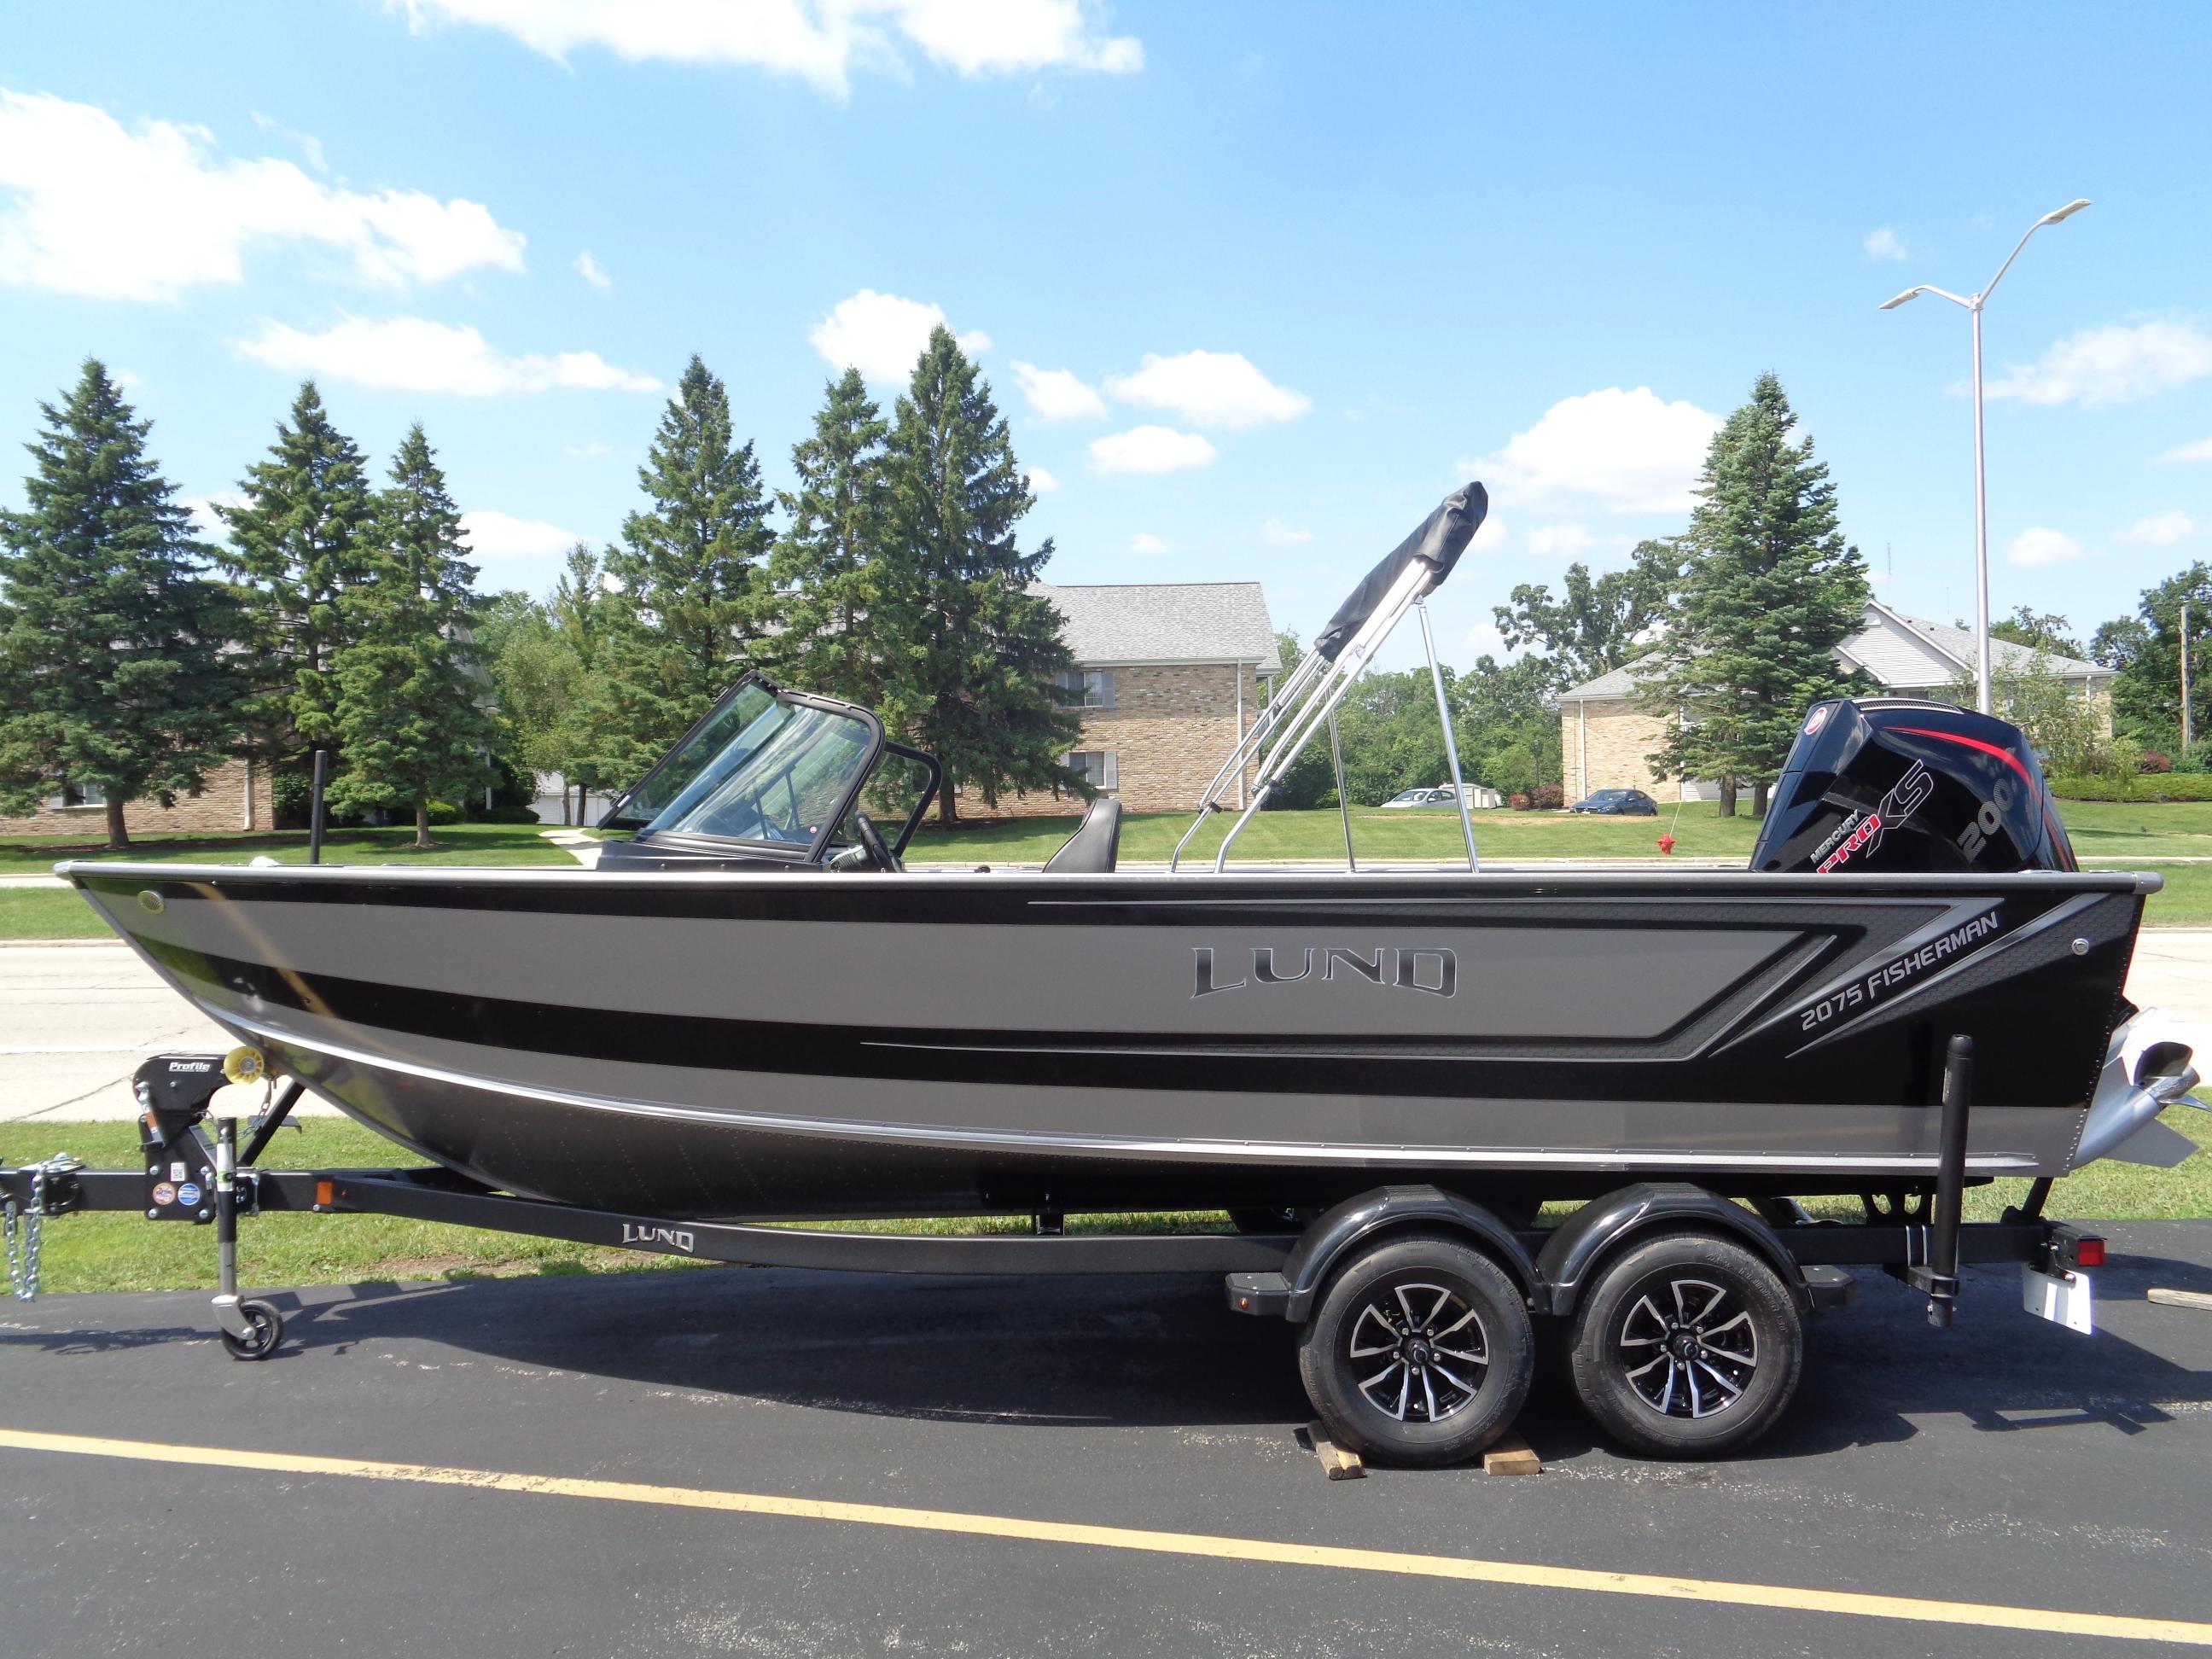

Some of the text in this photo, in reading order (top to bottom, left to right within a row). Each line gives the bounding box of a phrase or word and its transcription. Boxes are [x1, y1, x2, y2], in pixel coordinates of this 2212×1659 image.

[1809, 809, 1859, 864] MERCURY
[1957, 777, 2014, 864] 200
[1190, 947, 1458, 998] LUND
[1800, 911, 1998, 1031] 2075 FISHERMAN
[169, 1062, 211, 1070] Profile
[622, 1223, 694, 1253] LUND
